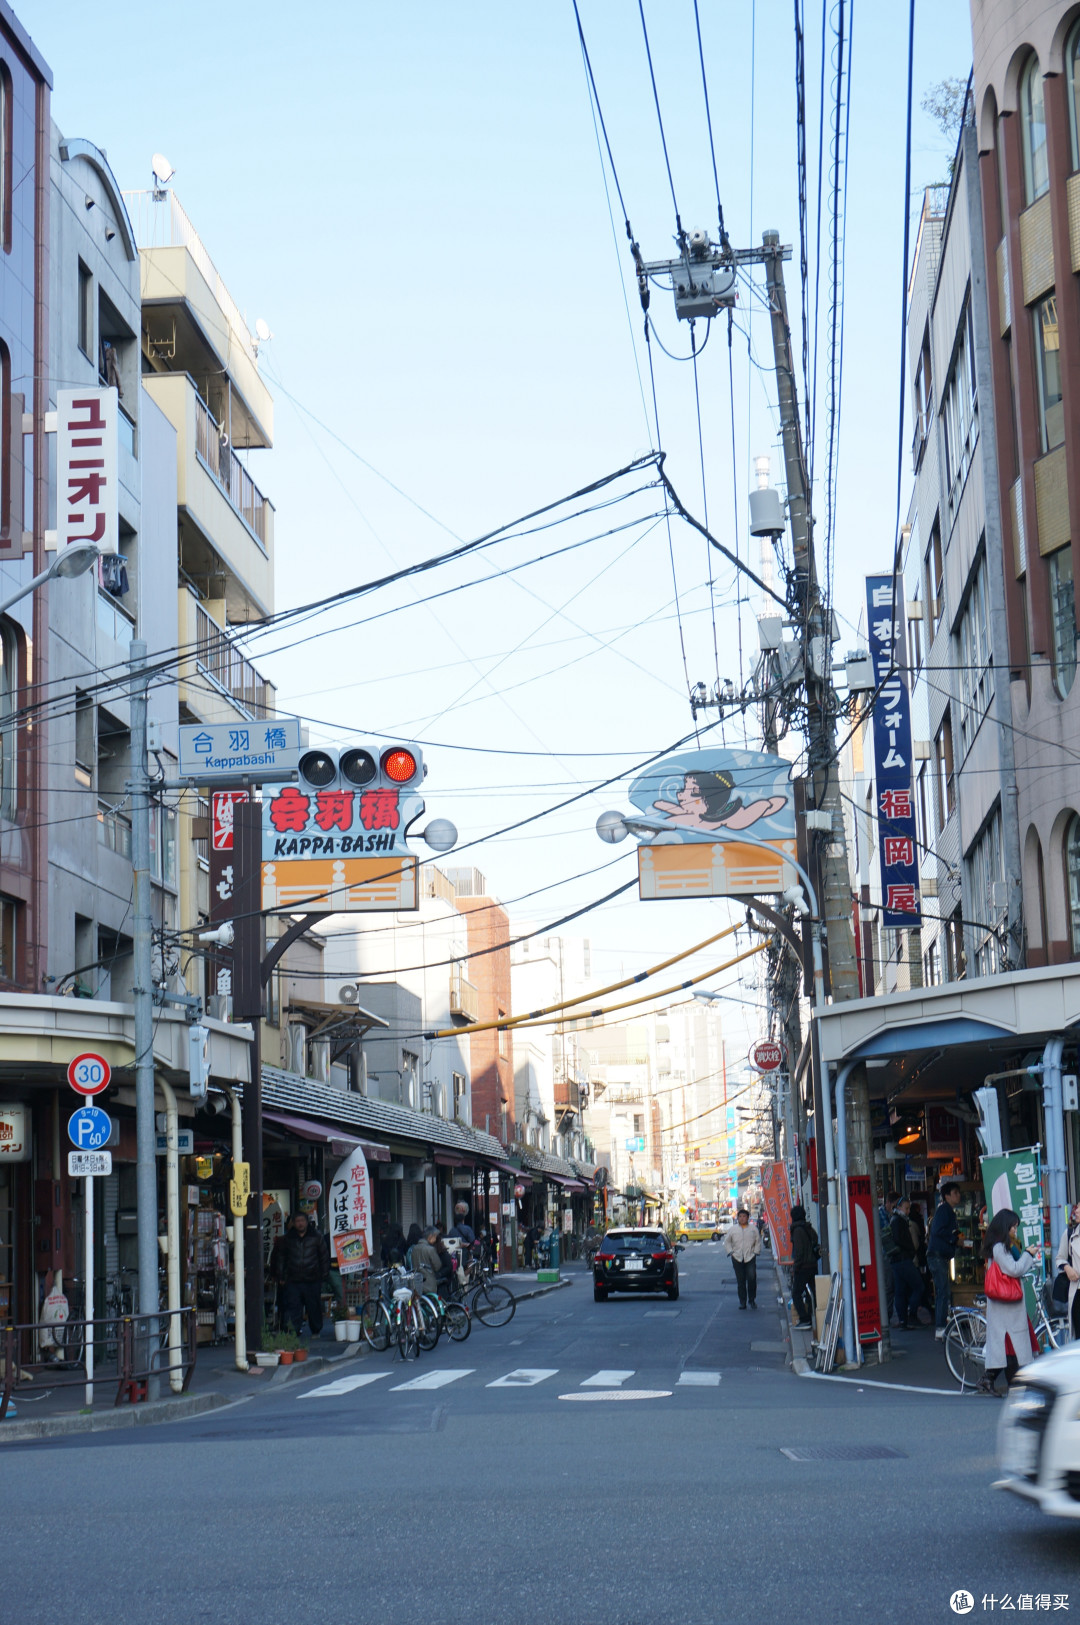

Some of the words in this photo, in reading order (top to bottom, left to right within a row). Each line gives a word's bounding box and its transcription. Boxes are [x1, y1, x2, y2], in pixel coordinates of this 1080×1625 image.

[67, 398, 107, 546] ユニオン
[192, 727, 286, 754] 合羽橋
[205, 754, 275, 769] Kappabashi
[270, 787, 400, 832] 合羽橋
[880, 789, 918, 917] 福岡屋
[78, 1064, 101, 1083] 30
[756, 1050, 780, 1063] 消火栓
[78, 1119, 94, 1145] P
[333, 1180, 349, 1232] つば屋
[1014, 1162, 1043, 1268] 包丁専門
